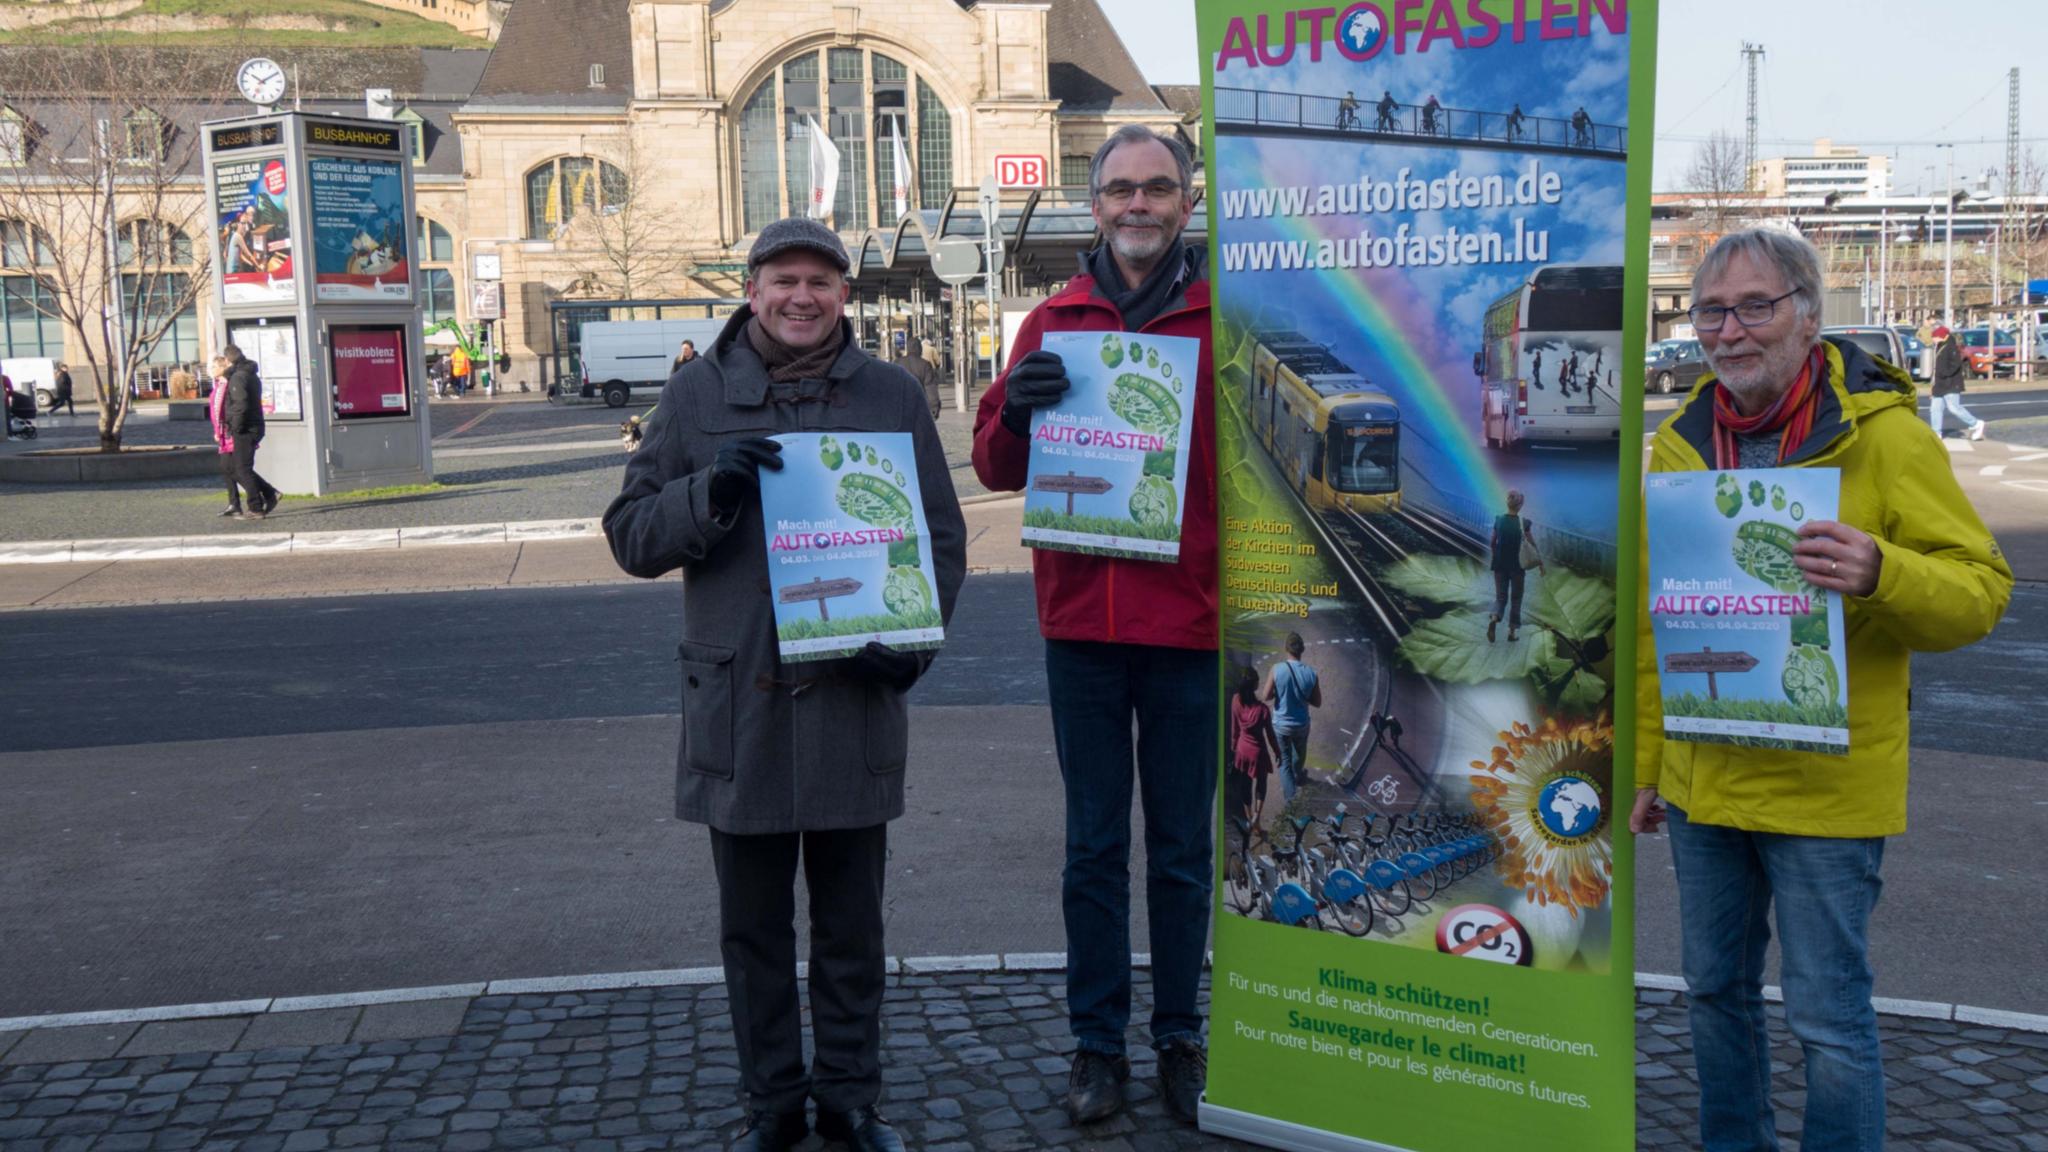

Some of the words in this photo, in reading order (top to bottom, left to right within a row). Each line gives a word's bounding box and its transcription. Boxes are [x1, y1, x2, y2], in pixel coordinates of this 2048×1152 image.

[1216, 0, 1628, 71] AUTOFASTEN
[314, 127, 391, 145] BUSBAHNHOF
[312, 162, 351, 173] GESCHENKE
[352, 165, 367, 174] AUS
[367, 166, 397, 177] KOBLENZ
[313, 172, 328, 181] UND
[329, 173, 343, 182] DER
[1001, 161, 1039, 186] DB
[1222, 159, 1562, 218] www.autofasten.de
[1222, 218, 1549, 272] www.autofasten.lu
[1045, 411, 1076, 424] Mach
[1080, 414, 1103, 425] mit!
[1035, 424, 1165, 452] AUTOFASTEN
[1042, 446, 1070, 457] 04.03.
[1084, 450, 1136, 462] 04.04.2020
[777, 519, 811, 531] Mach
[814, 518, 837, 530] mit!
[1225, 516, 1248, 531] Eine
[1251, 519, 1293, 534] Aktion
[771, 528, 905, 553] AUTOFASTEN
[1226, 536, 1242, 550] der
[1245, 538, 1292, 554] Kirchen
[1297, 542, 1316, 556] im
[781, 555, 811, 565] 04.03.
[826, 550, 880, 562] 04.04.2020
[1226, 574, 1306, 595] Deutschlands
[1311, 581, 1338, 597] und
[1662, 578, 1700, 592] Mach
[1704, 578, 1733, 591] mit!
[1227, 595, 1235, 607] in
[1238, 596, 1309, 618] Luxemburg
[1653, 594, 1812, 617] AUTOFASTEN
[1665, 620, 1700, 630] 04.03.
[1716, 620, 1780, 631] 04.04.2020
[1318, 967, 1377, 996] Klima
[1385, 983, 1490, 1017] schützen!
[1229, 971, 1248, 992] Für
[1253, 982, 1279, 999] uns
[1283, 985, 1311, 1004] und
[1316, 988, 1339, 1009] die
[1343, 995, 1476, 1036] nachkommenden
[1482, 1021, 1599, 1058] Generationen.
[1288, 1010, 1415, 1053] Sauvegarder
[1423, 1034, 1442, 1059] le
[1449, 1042, 1527, 1075] climat!
[1235, 1020, 1265, 1041] Pour
[1270, 1029, 1308, 1051] notre
[1312, 1034, 1344, 1058] bien
[1348, 1047, 1362, 1062] et
[1367, 1053, 1402, 1074] pour
[1406, 1056, 1428, 1077] les
[1433, 1066, 1524, 1096] générations
[1529, 1080, 1591, 1109] futures.
